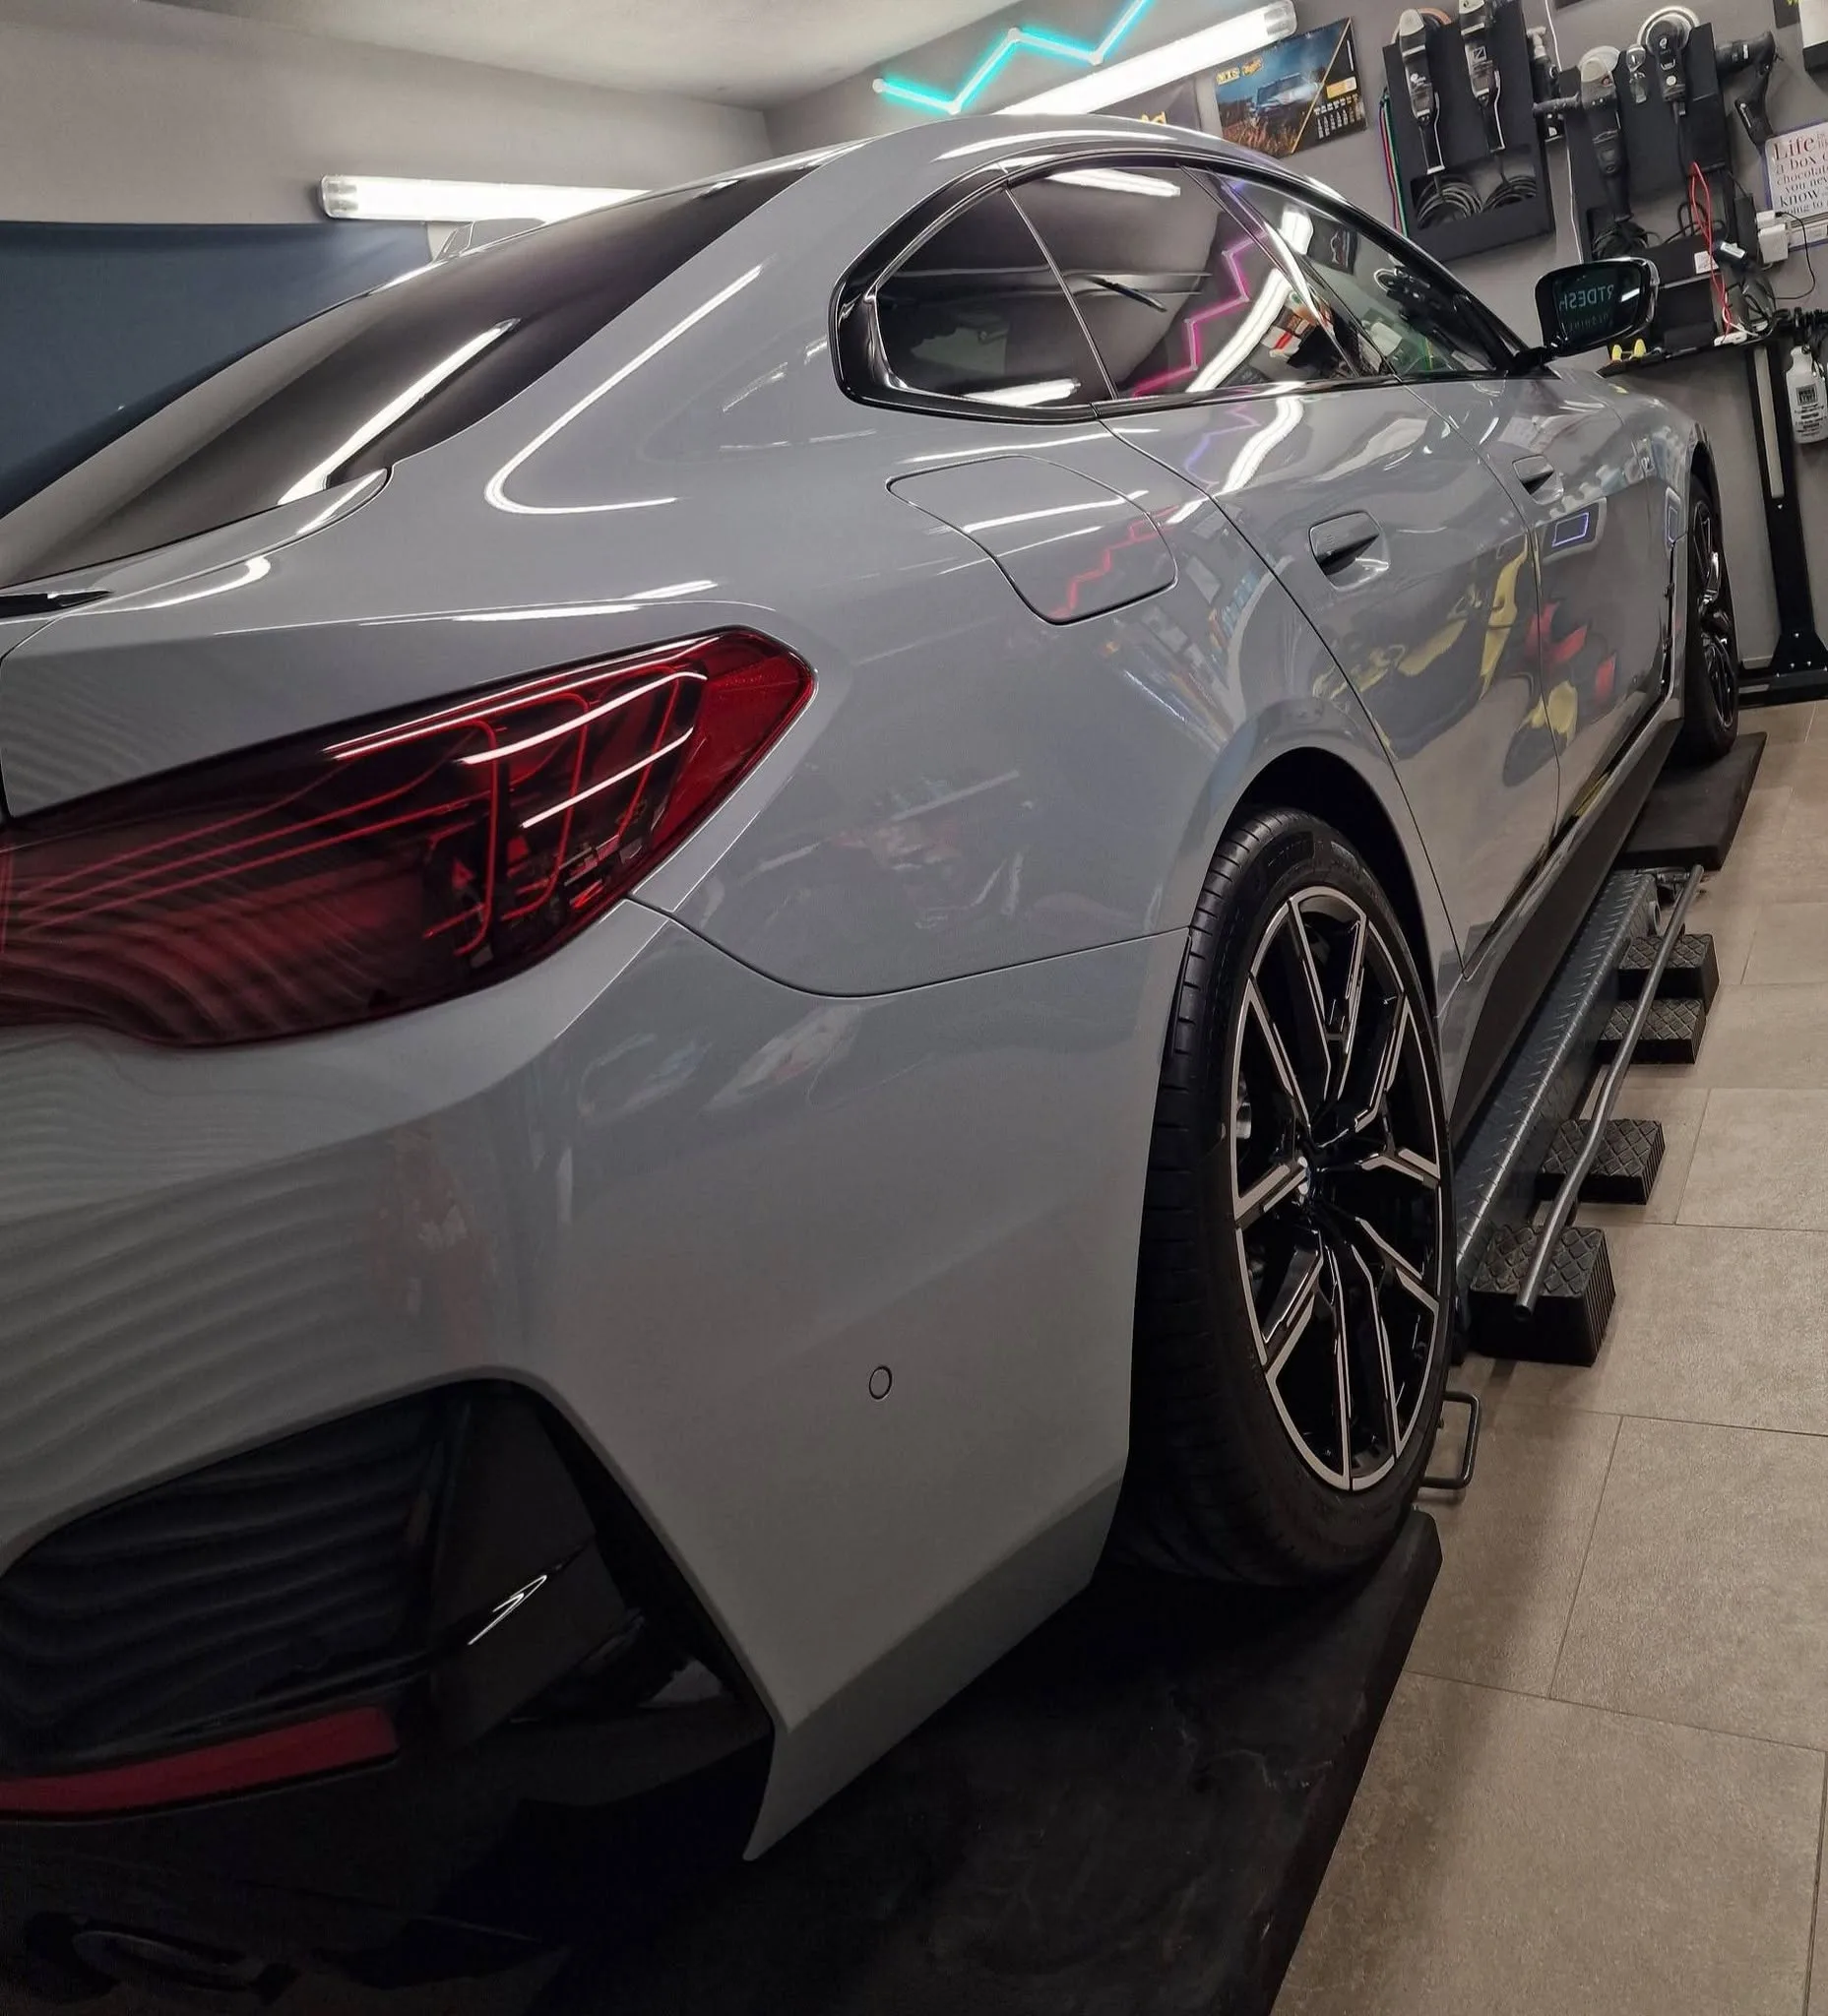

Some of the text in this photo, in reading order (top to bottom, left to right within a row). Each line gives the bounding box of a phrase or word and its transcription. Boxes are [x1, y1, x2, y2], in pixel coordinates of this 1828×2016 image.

[1774, 138, 1816, 160] Life
[1790, 156, 1816, 170] box
[1777, 165, 1828, 185] chocolat
[1785, 182, 1805, 194] you
[1780, 189, 1819, 208] know
